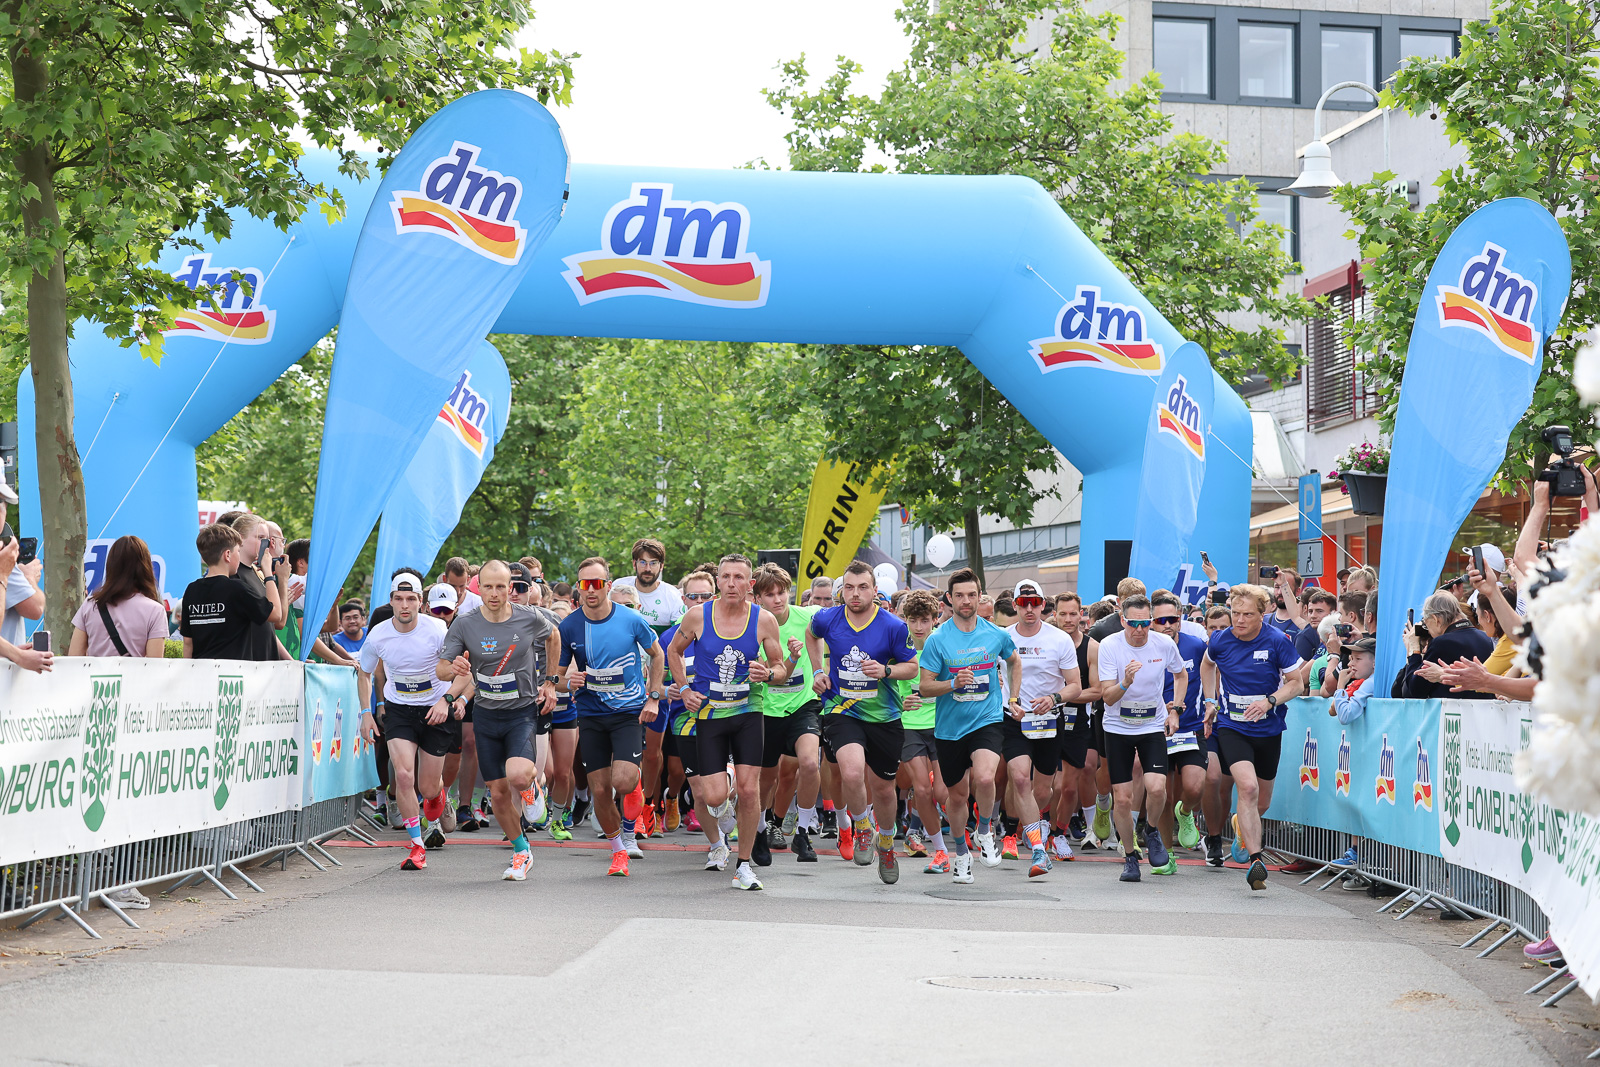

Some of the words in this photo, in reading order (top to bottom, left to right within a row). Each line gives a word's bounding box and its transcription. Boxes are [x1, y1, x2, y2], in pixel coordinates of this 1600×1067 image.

[426, 148, 517, 223] dm
[610, 188, 742, 259] dm
[1462, 248, 1533, 323] dm
[1060, 290, 1142, 342] dm
[1168, 379, 1199, 432] dm
[1304, 483, 1316, 532] P
[188, 602, 225, 614] NITED
[123, 703, 145, 734] Kreis-
[156, 700, 214, 732] Universitätsstadt
[117, 746, 210, 800] HOMBURG
[235, 737, 299, 784] HOMBURG
[1303, 731, 1317, 767] dm
[1338, 734, 1350, 771] dm
[1381, 738, 1393, 778] dm
[1417, 741, 1429, 783] dm
